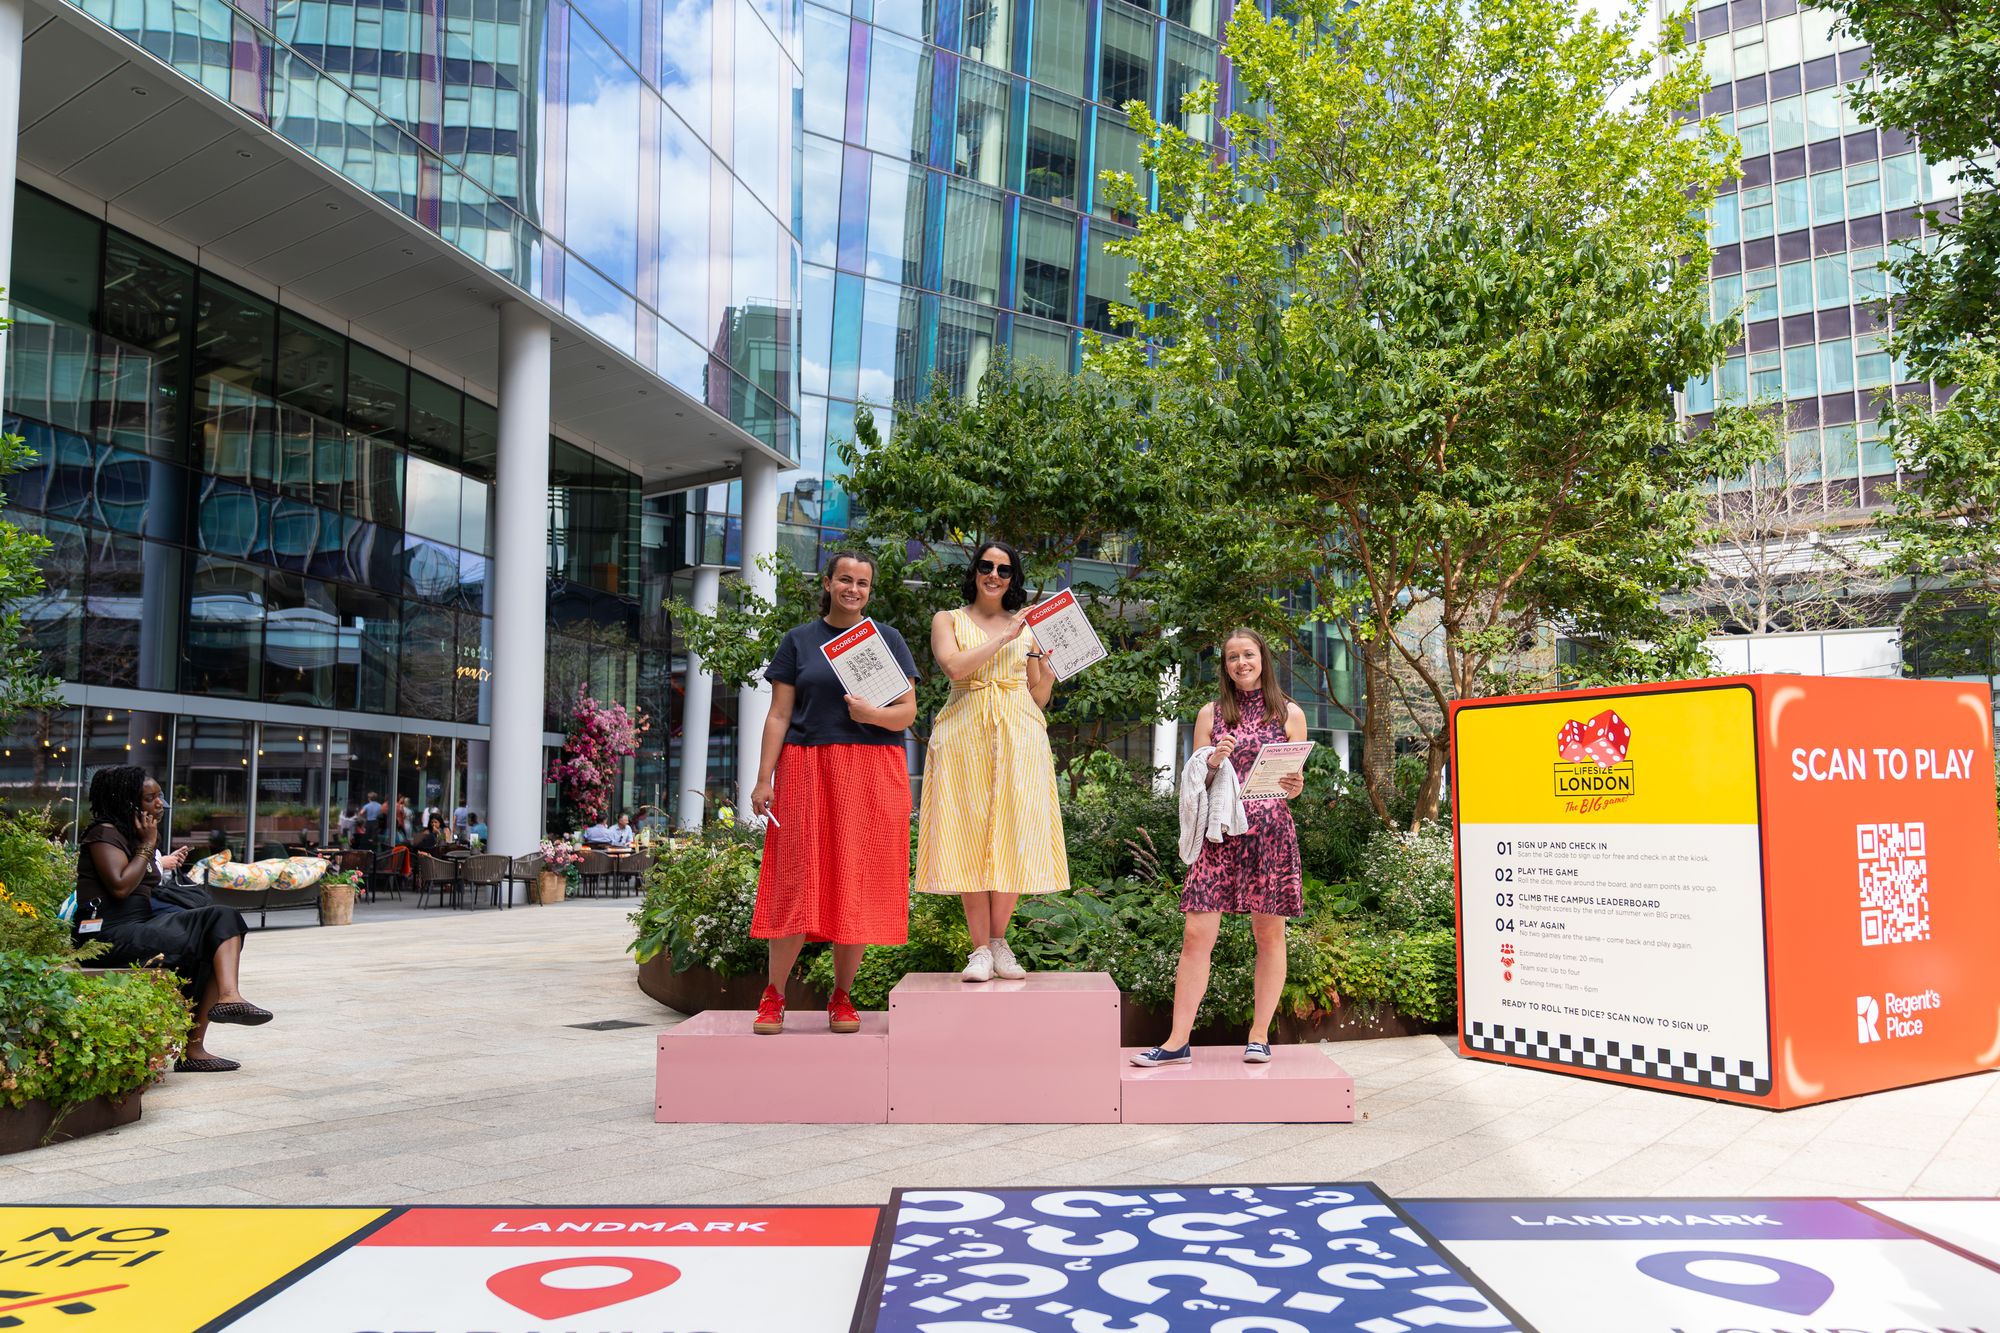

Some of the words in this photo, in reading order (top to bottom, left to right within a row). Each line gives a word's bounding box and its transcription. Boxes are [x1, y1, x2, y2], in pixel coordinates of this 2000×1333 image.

[1032, 598, 1066, 620] SCORECARD
[832, 628, 868, 652] SCORECARD
[1574, 766, 1613, 775] LIFESIZE
[1792, 748, 1866, 781] SCAN
[1873, 748, 1908, 780] TO
[1915, 749, 1974, 780] PLAY
[1560, 776, 1629, 791] LONDON
[1565, 801, 1578, 813] The
[1580, 796, 1603, 814] BIG
[1497, 842, 1512, 855] 01
[1518, 841, 1535, 849] SIGN
[1569, 842, 1596, 850] CHECK
[1599, 842, 1607, 850] IN
[1579, 852, 1591, 860] sign
[1495, 868, 1513, 881] 02
[1496, 893, 1513, 907] 03
[1544, 895, 1558, 903] THE
[1561, 896, 1594, 904] CAMPUS
[1597, 897, 1660, 908] LEADERBOARD
[1616, 909, 1641, 917] summer
[1496, 918, 1514, 932] 04
[1520, 920, 1538, 928] PLAY
[1540, 921, 1565, 930] AGAIN
[1657, 940, 1670, 948] play
[1520, 950, 1548, 958] Estimated
[1550, 966, 1558, 974] Up
[1569, 968, 1580, 976] four
[1520, 979, 1544, 988] Opening
[1584, 985, 1598, 993] 6pm
[1885, 989, 1940, 1018] Regent's
[1502, 999, 1527, 1009] READY
[1529, 1002, 1540, 1011] TO
[1542, 1004, 1562, 1013] ROLL
[1564, 1007, 1579, 1016] THE
[1581, 1009, 1605, 1019] DICE?
[1607, 1012, 1630, 1022] SCAN
[1633, 1016, 1654, 1025] NOW
[1658, 1019, 1669, 1027] TO
[1672, 1021, 1694, 1030] SIGN
[1696, 1024, 1710, 1033] UP.
[1886, 1016, 1923, 1039] Place
[490, 1221, 770, 1233] LANDMARK
[1510, 1214, 1784, 1226] LANDMARK
[18, 1226, 170, 1243] NO
